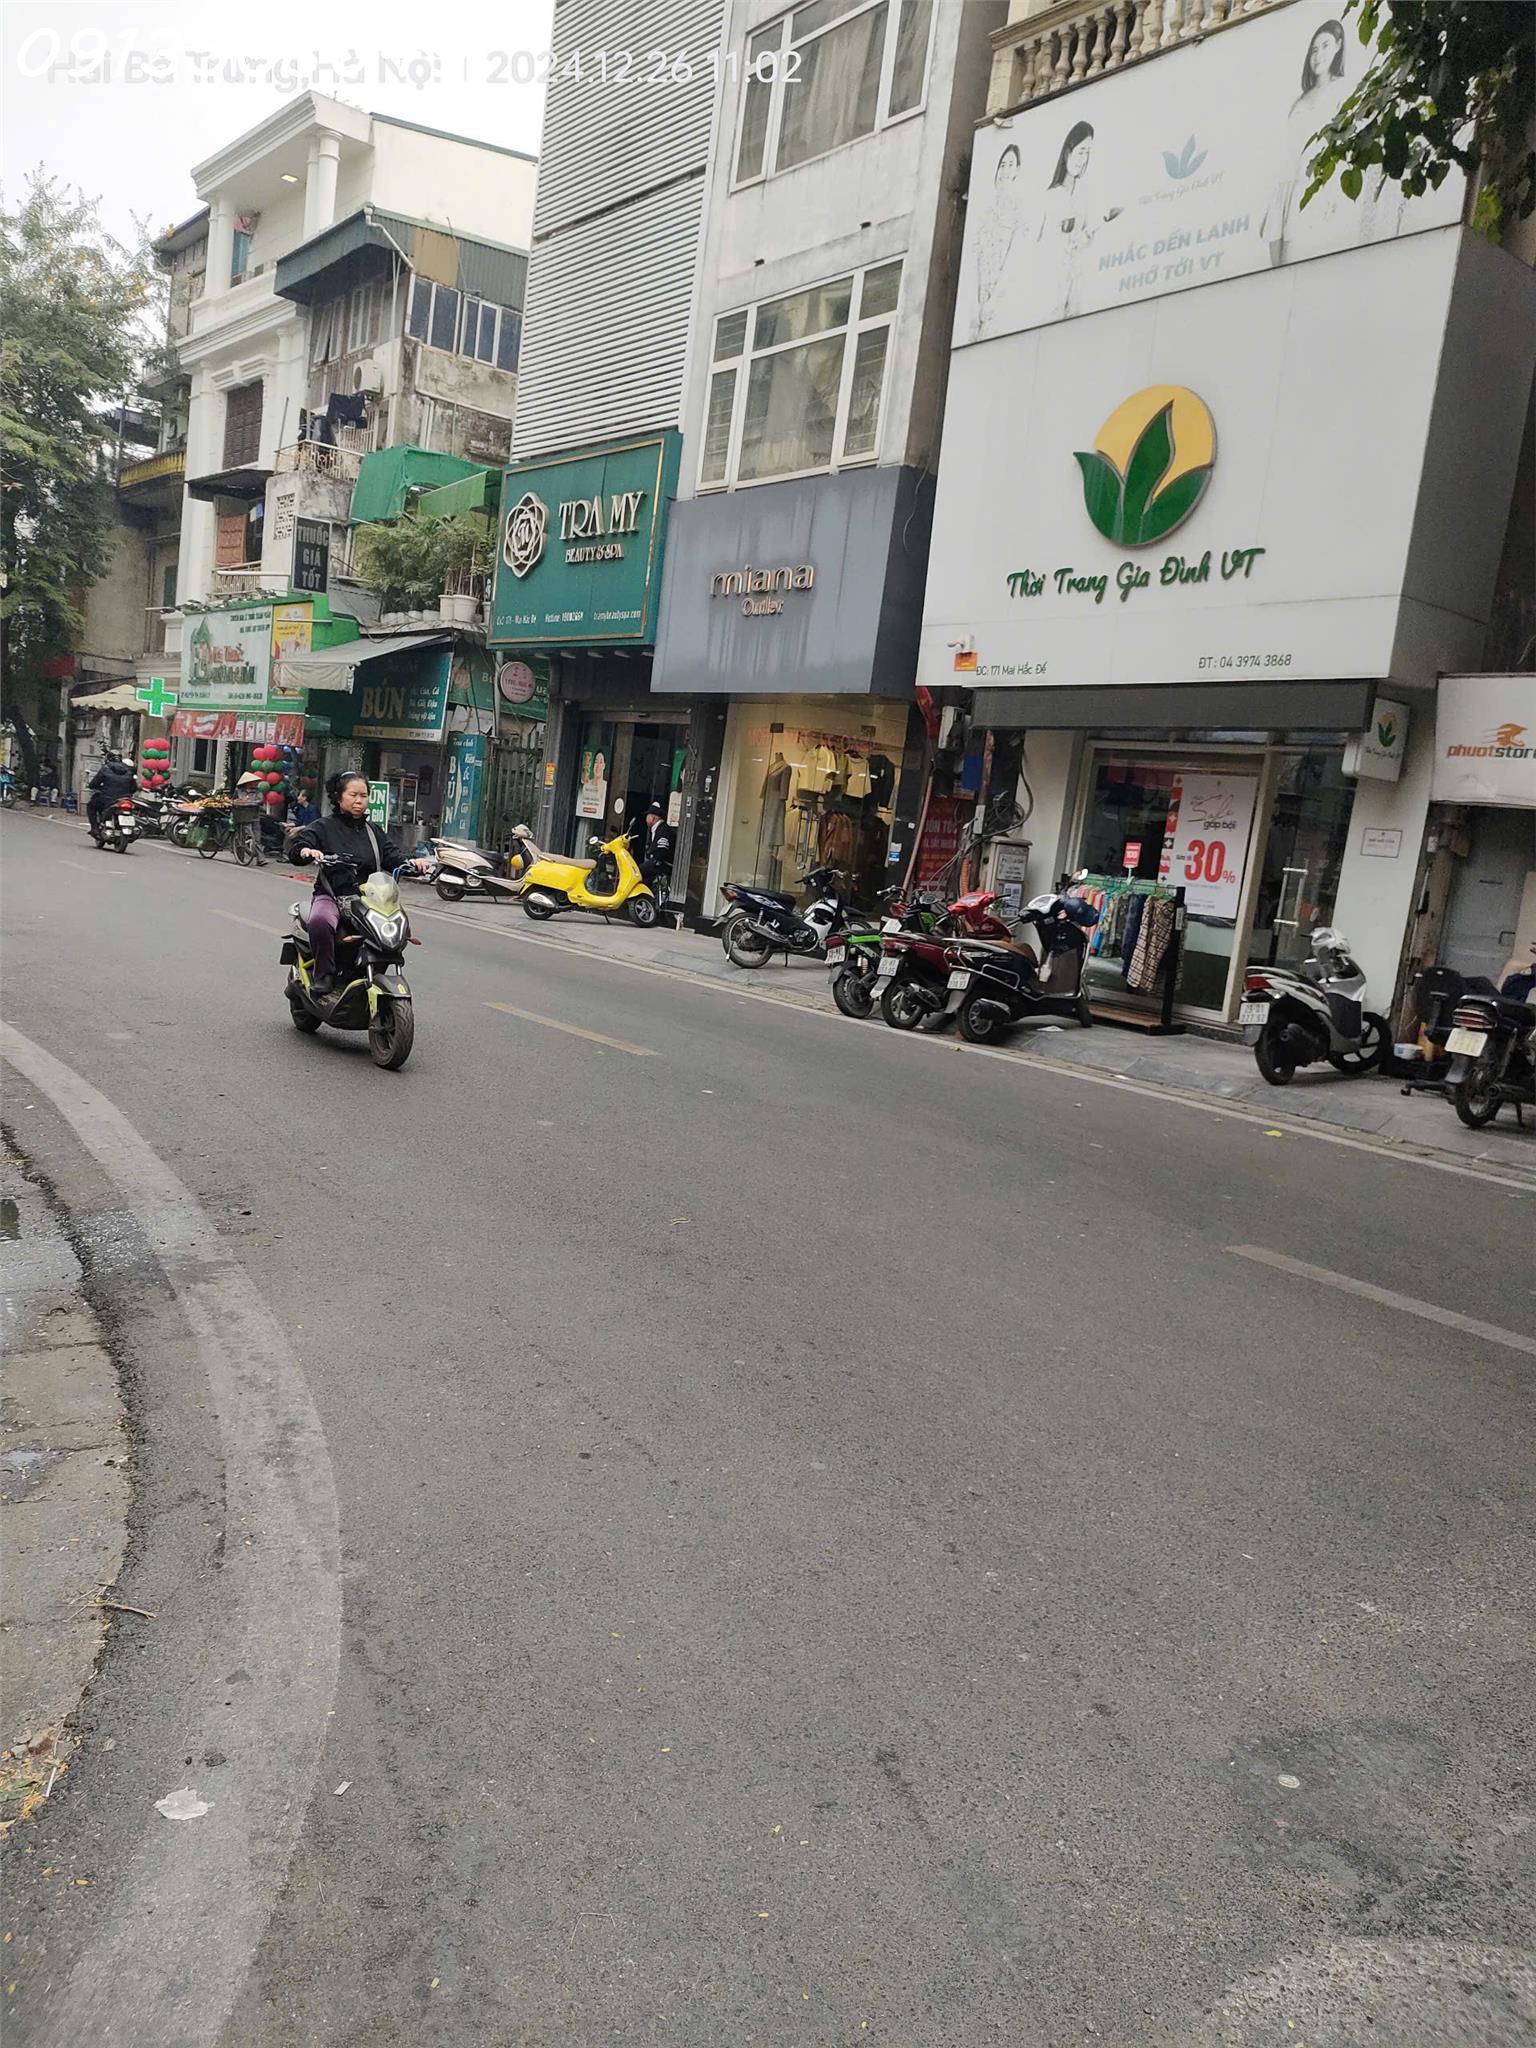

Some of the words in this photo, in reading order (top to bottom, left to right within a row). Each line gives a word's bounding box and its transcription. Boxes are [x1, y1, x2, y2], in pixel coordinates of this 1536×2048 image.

[1200, 251, 1224, 271] VT
[609, 490, 648, 534] MY
[297, 523, 329, 547] THUỐC
[303, 546, 321, 567] GIÁ
[564, 546, 595, 565] BEAUTY
[302, 566, 321, 589] TỐT
[710, 564, 816, 597] miana
[1007, 569, 1046, 599] Thời
[1054, 567, 1109, 604] Trang
[1116, 561, 1151, 602] Gia
[1159, 550, 1212, 586] Đình
[1221, 548, 1266, 581] VT
[1002, 665, 1015, 675] Mai
[1219, 656, 1233, 668] 04
[1235, 655, 1261, 668] 3974
[1264, 653, 1292, 667] 3868
[361, 678, 407, 719] BÚN
[368, 784, 386, 805] ÚN
